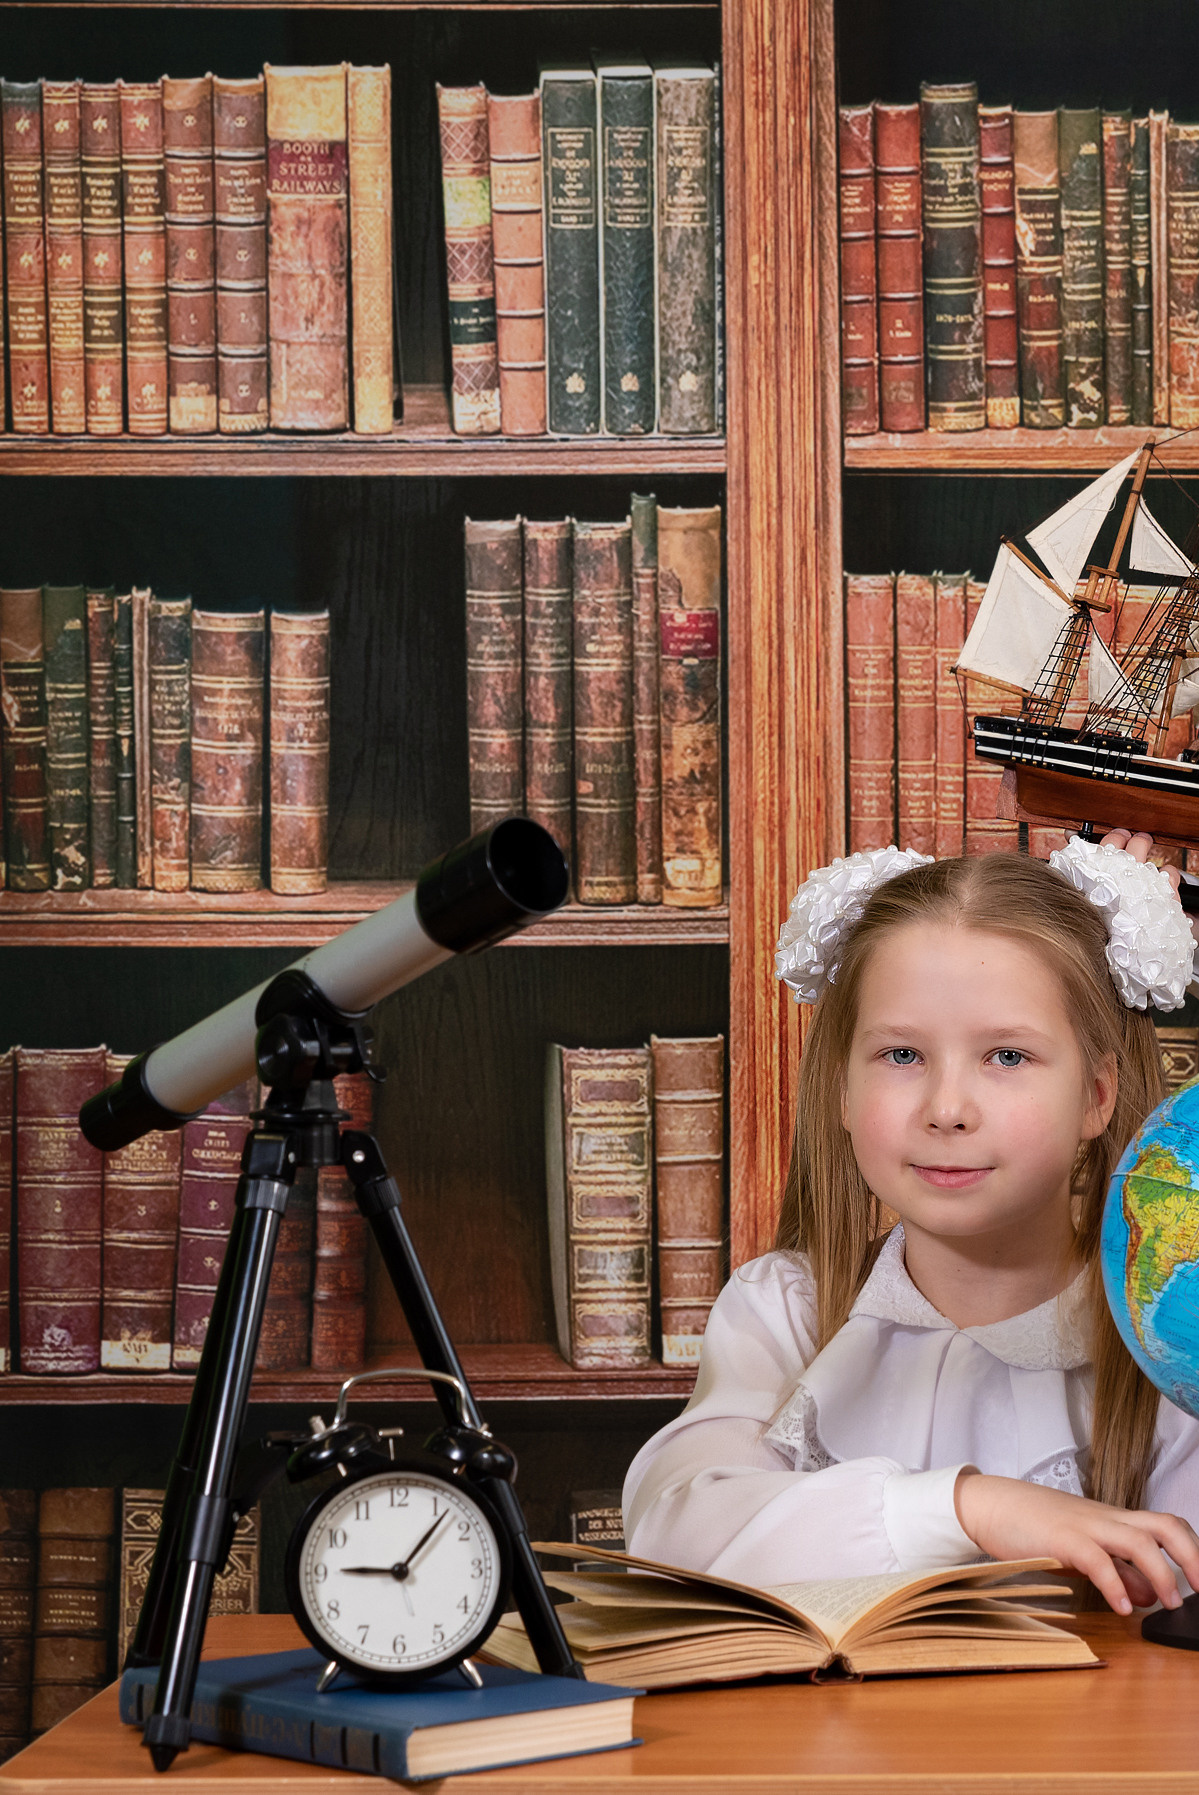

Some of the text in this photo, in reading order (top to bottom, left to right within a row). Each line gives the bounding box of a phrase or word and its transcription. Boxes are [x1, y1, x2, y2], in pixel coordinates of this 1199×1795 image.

[279, 163, 335, 176] STREET
[271, 179, 342, 193] RAILWAYS
[137, 1205, 147, 1216] 3
[388, 1486, 409, 1508] 12
[433, 1497, 439, 1517] 1
[355, 1501, 371, 1520] 11
[328, 1528, 348, 1548] 10
[457, 1521, 471, 1542] 2
[314, 1563, 328, 1583] 9
[470, 1559, 483, 1579] 3
[326, 1599, 340, 1620] 8
[456, 1594, 471, 1615] 4
[357, 1624, 370, 1645] 7
[432, 1624, 445, 1644] 5
[392, 1634, 406, 1655] 6
